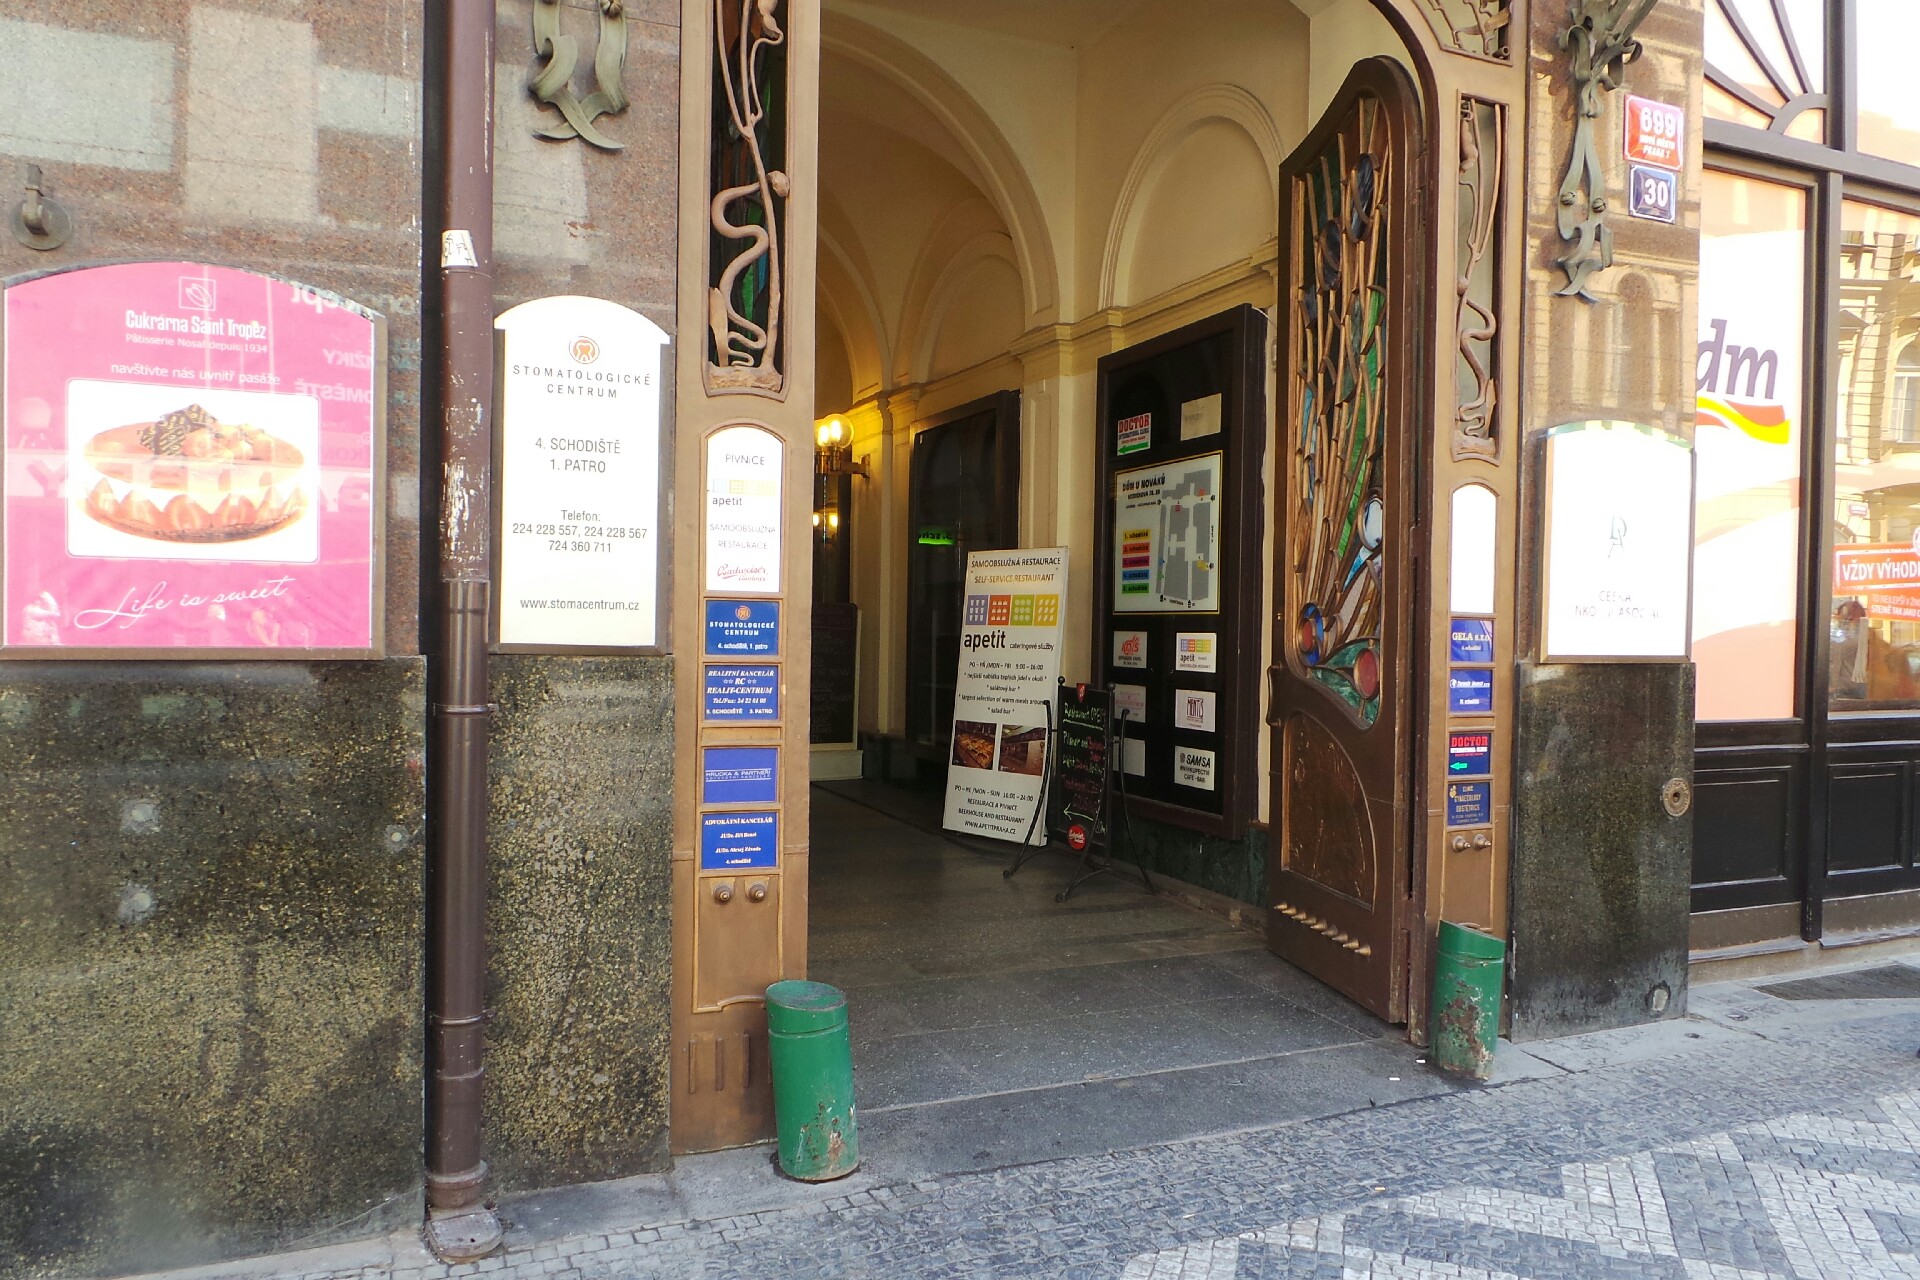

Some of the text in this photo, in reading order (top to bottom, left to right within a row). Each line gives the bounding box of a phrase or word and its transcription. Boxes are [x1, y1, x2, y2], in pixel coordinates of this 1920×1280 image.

[1640, 106, 1676, 138] 699
[1642, 145, 1665, 159] PRAHA
[1644, 178, 1669, 207] 30
[126, 309, 189, 333] Cukrárna
[190, 315, 224, 336] Saint
[208, 342, 242, 354] depuis
[244, 344, 268, 354] 1934
[1697, 318, 1779, 400] dm
[111, 361, 280, 386] navštivte nás uvnitř pasáže
[513, 364, 651, 386] STOMATOLOGICKÉ
[546, 383, 618, 399] CENTRUM
[1119, 414, 1150, 433] DOCTOR
[535, 436, 621, 454] 4. SCHODIŠTĚ
[550, 459, 606, 473] 1. PATRO
[725, 454, 765, 466] PIVNICE
[712, 496, 743, 507] apetit
[561, 509, 601, 522] Telefon:
[512, 523, 648, 539] 224 228 557, 224 228 567
[548, 540, 612, 553] 724 360 711
[971, 557, 1061, 568] SAMOOBSLUŽNÁ RESTAURACE
[1842, 558, 1874, 581] VŽDY
[974, 573, 1055, 584] SELF-SERVICE RESTAURANT
[74, 575, 297, 630] Life is sweet
[520, 598, 640, 611] www.stomacentrum.cz
[1871, 604, 1892, 615] STEJNĚ
[1892, 606, 1904, 615] TAK
[709, 621, 775, 629] STOMATOLOGICKÉ
[964, 629, 1006, 652] apetit
[1452, 632, 1474, 641] GELA
[1179, 653, 1195, 664] apetit
[740, 669, 774, 677] KANCELÁŘ
[707, 687, 773, 695] REALIT-CENTRUM
[1451, 736, 1488, 748] DOCTOR
[1186, 754, 1211, 768] SAMSA
[741, 816, 773, 824] KANCELÁŘ
